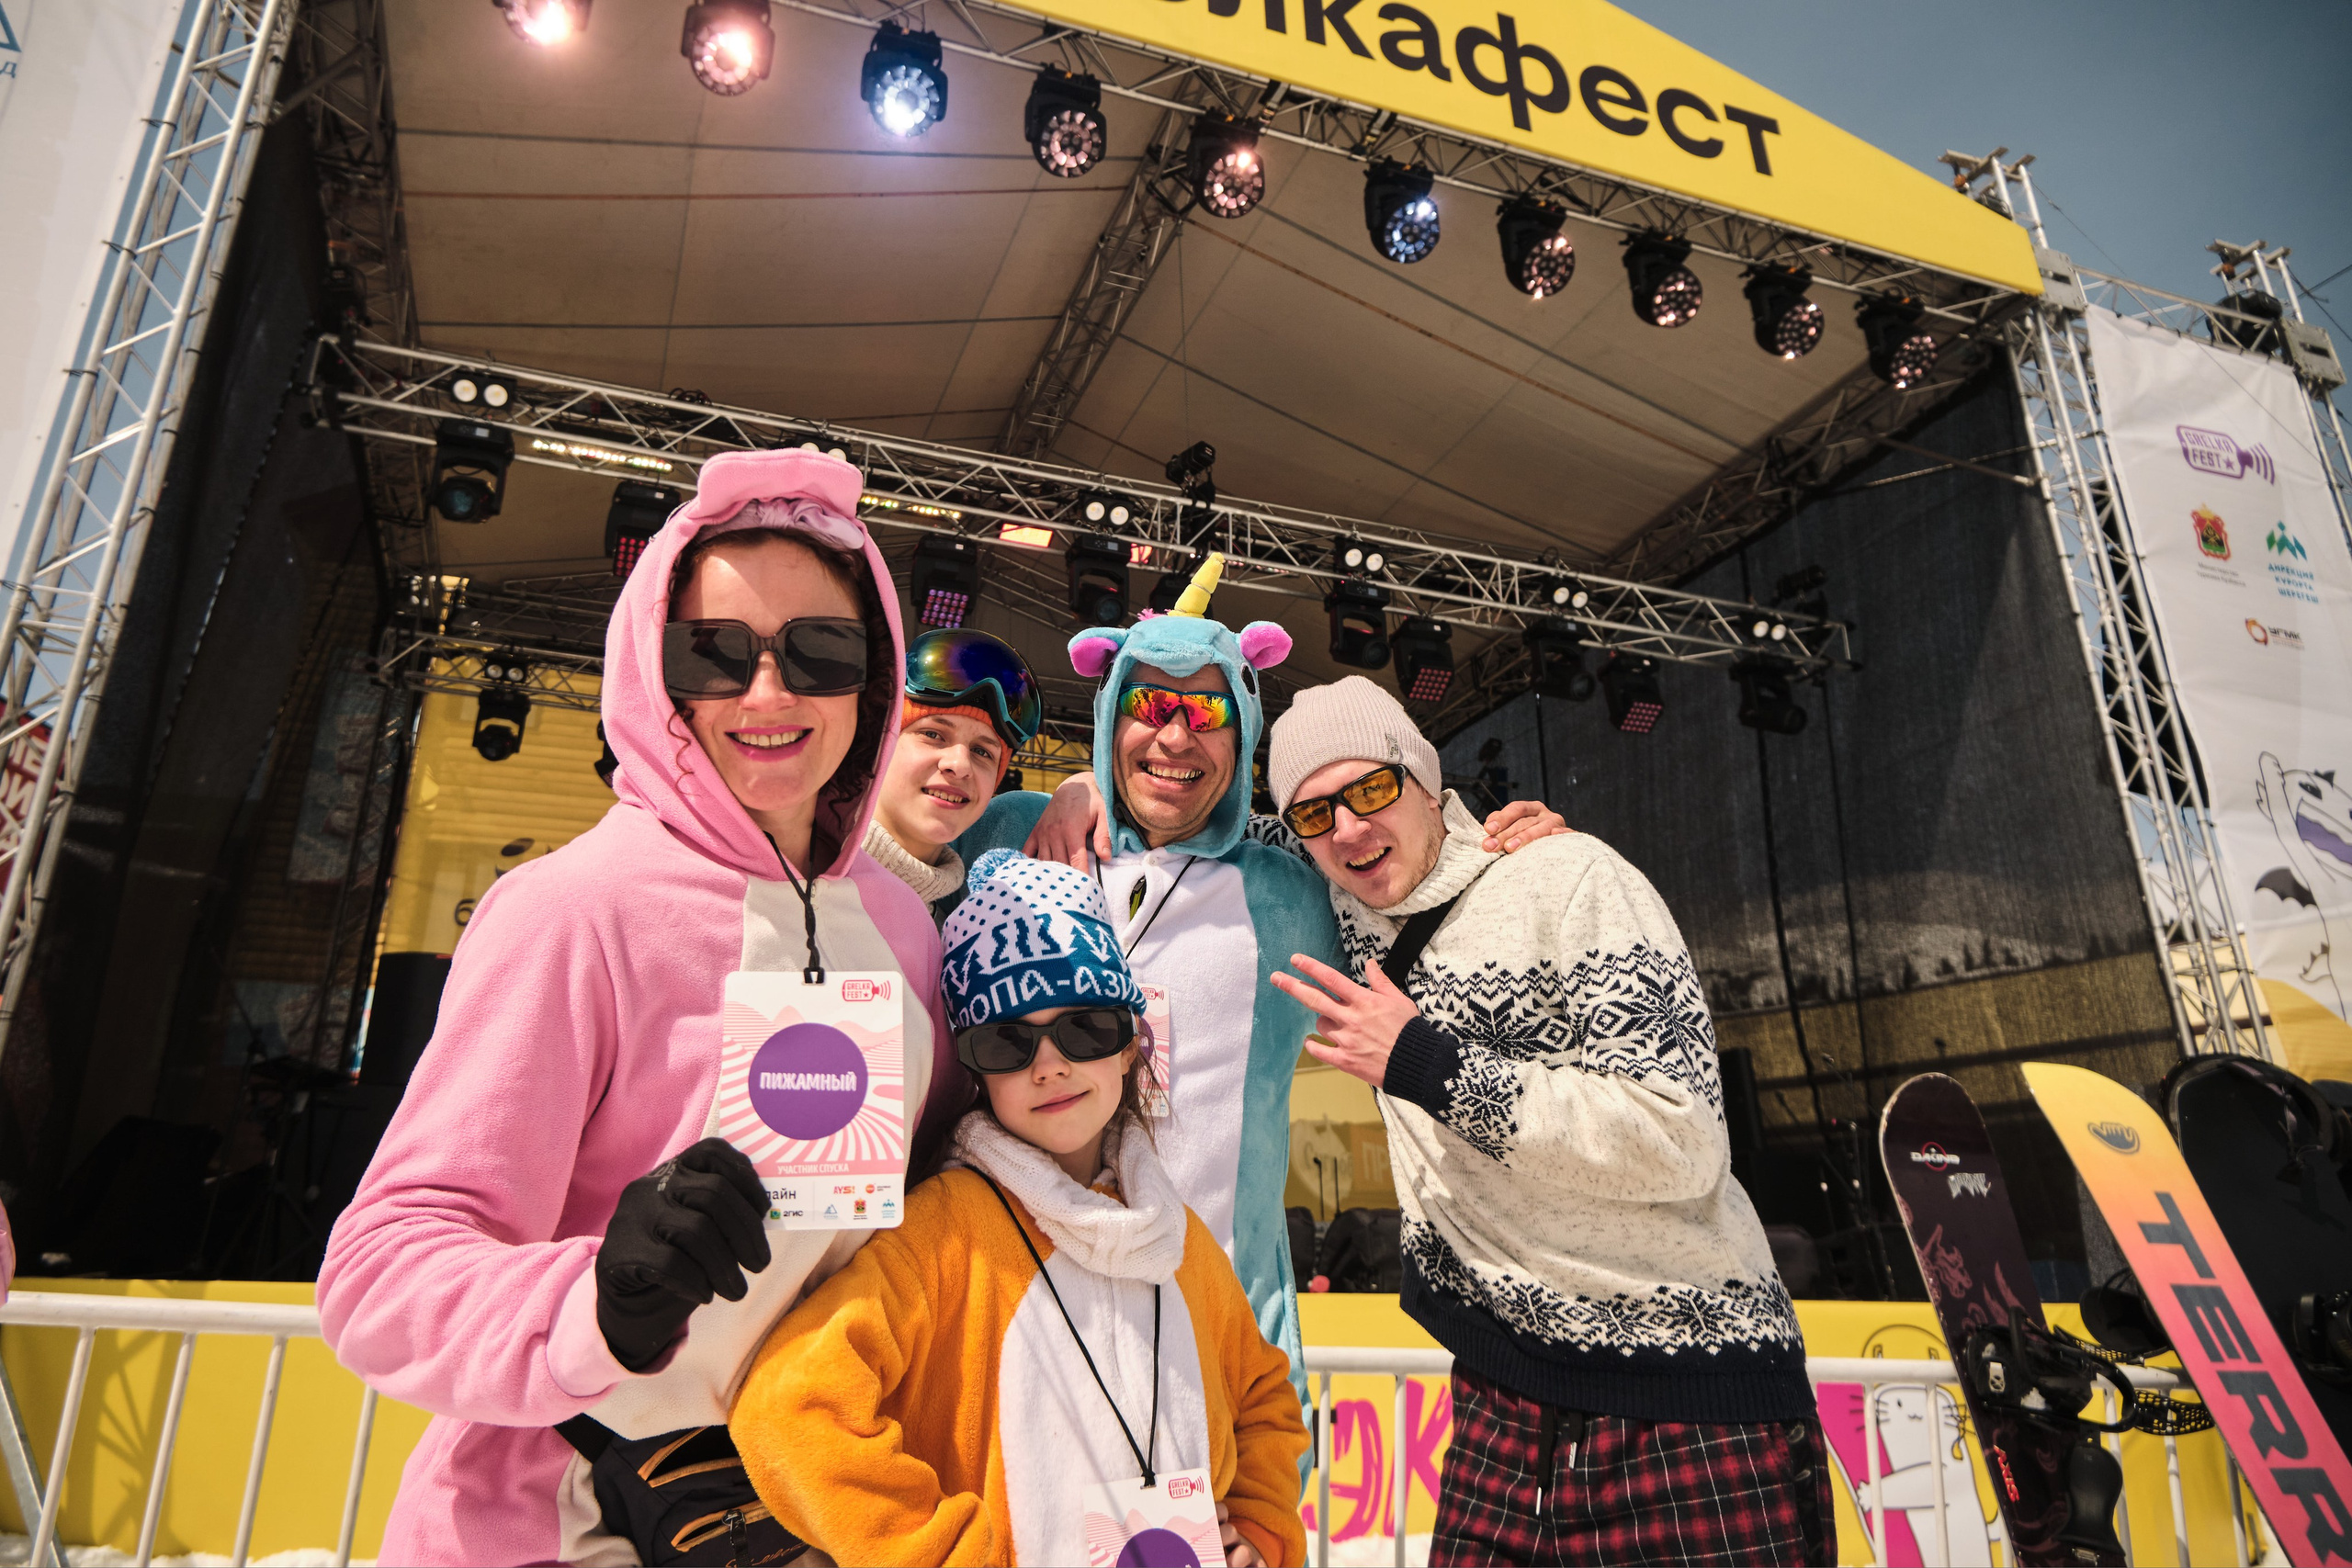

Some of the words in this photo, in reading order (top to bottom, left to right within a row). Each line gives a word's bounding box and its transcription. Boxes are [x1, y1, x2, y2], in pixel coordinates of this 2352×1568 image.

[2183, 430, 2233, 454] GRELKA
[2192, 448, 2222, 469] FEST
[2267, 562, 2314, 581] ДИРЕКЦИЯ
[2274, 575, 2314, 591] КУРОРТА
[2278, 588, 2319, 604] ШЕРЕГЕШ
[846, 982, 871, 990] GRELKA
[846, 990, 863, 998] FEST
[760, 1071, 857, 1091] ПИЖАМНЫЙ
[777, 1164, 819, 1175] УЧАСТНИК
[819, 1162, 849, 1173] СПУСКА
[1993, 1444, 2020, 1502] AXIS
[1172, 1488, 1184, 1496] FEST
